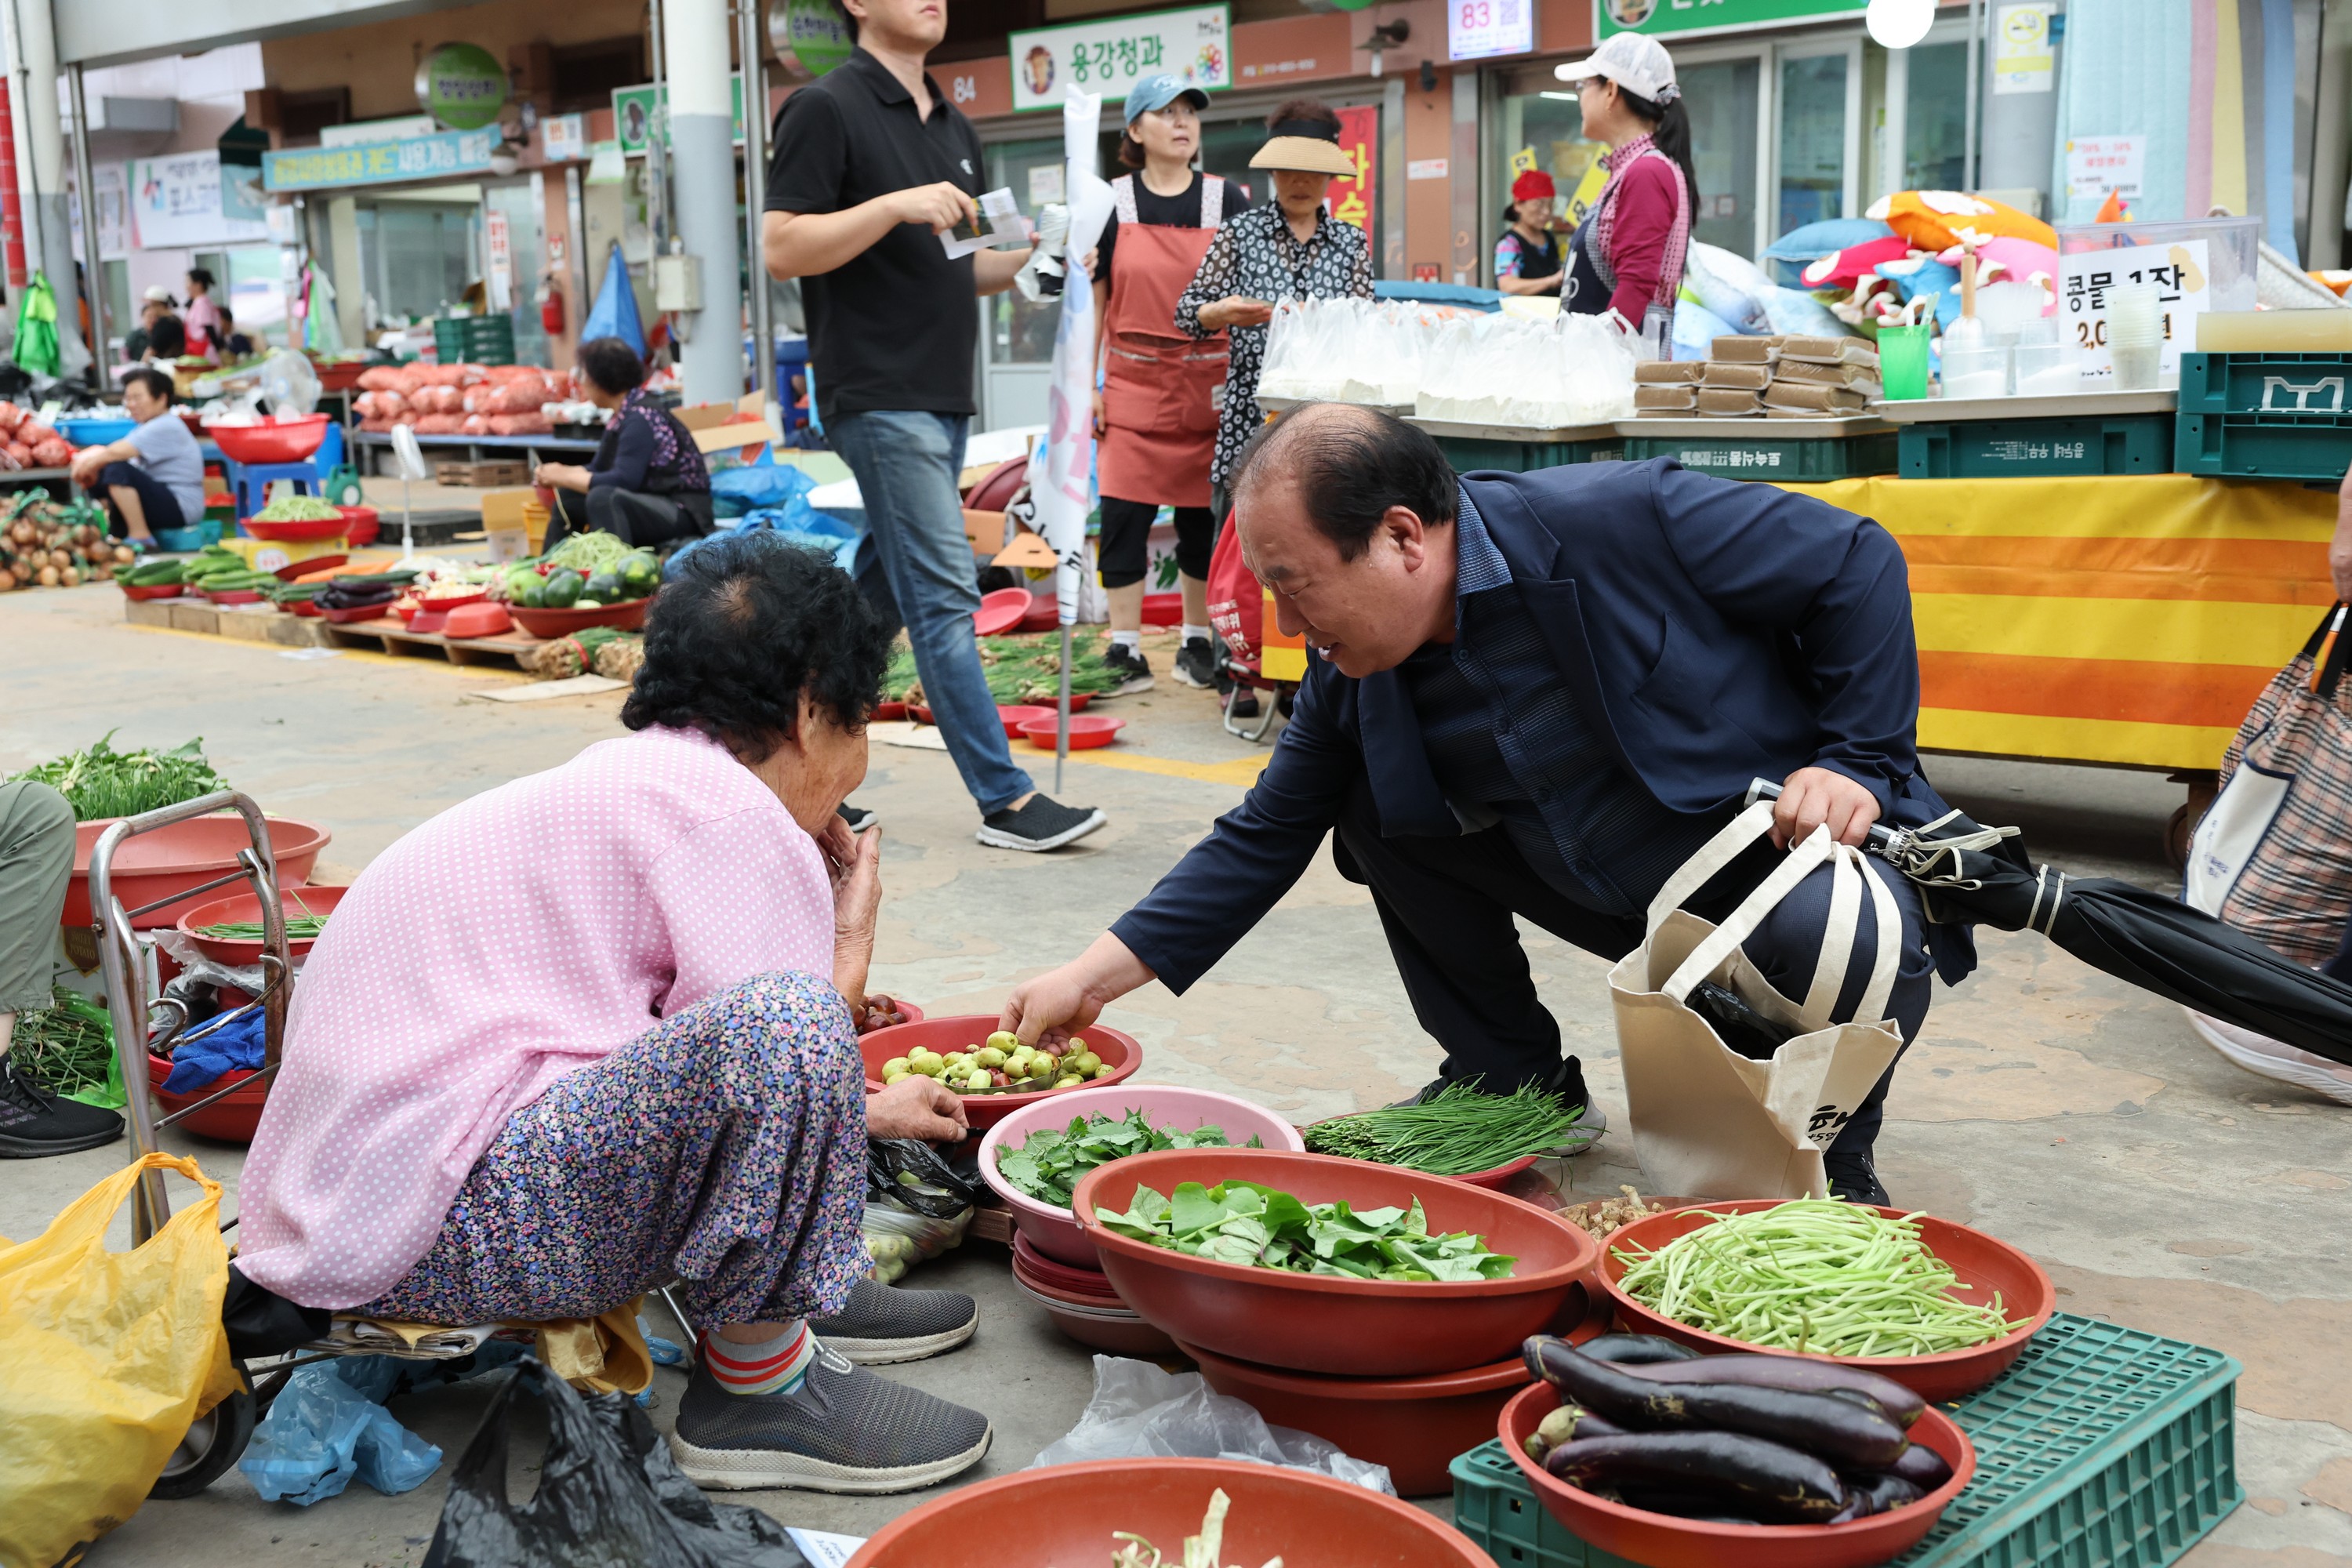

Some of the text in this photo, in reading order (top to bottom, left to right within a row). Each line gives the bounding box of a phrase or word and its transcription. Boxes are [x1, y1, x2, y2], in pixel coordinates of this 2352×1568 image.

[1462, 2, 1490, 28] 83
[1070, 34, 1164, 82] 용강청과
[953, 76, 976, 103] 84
